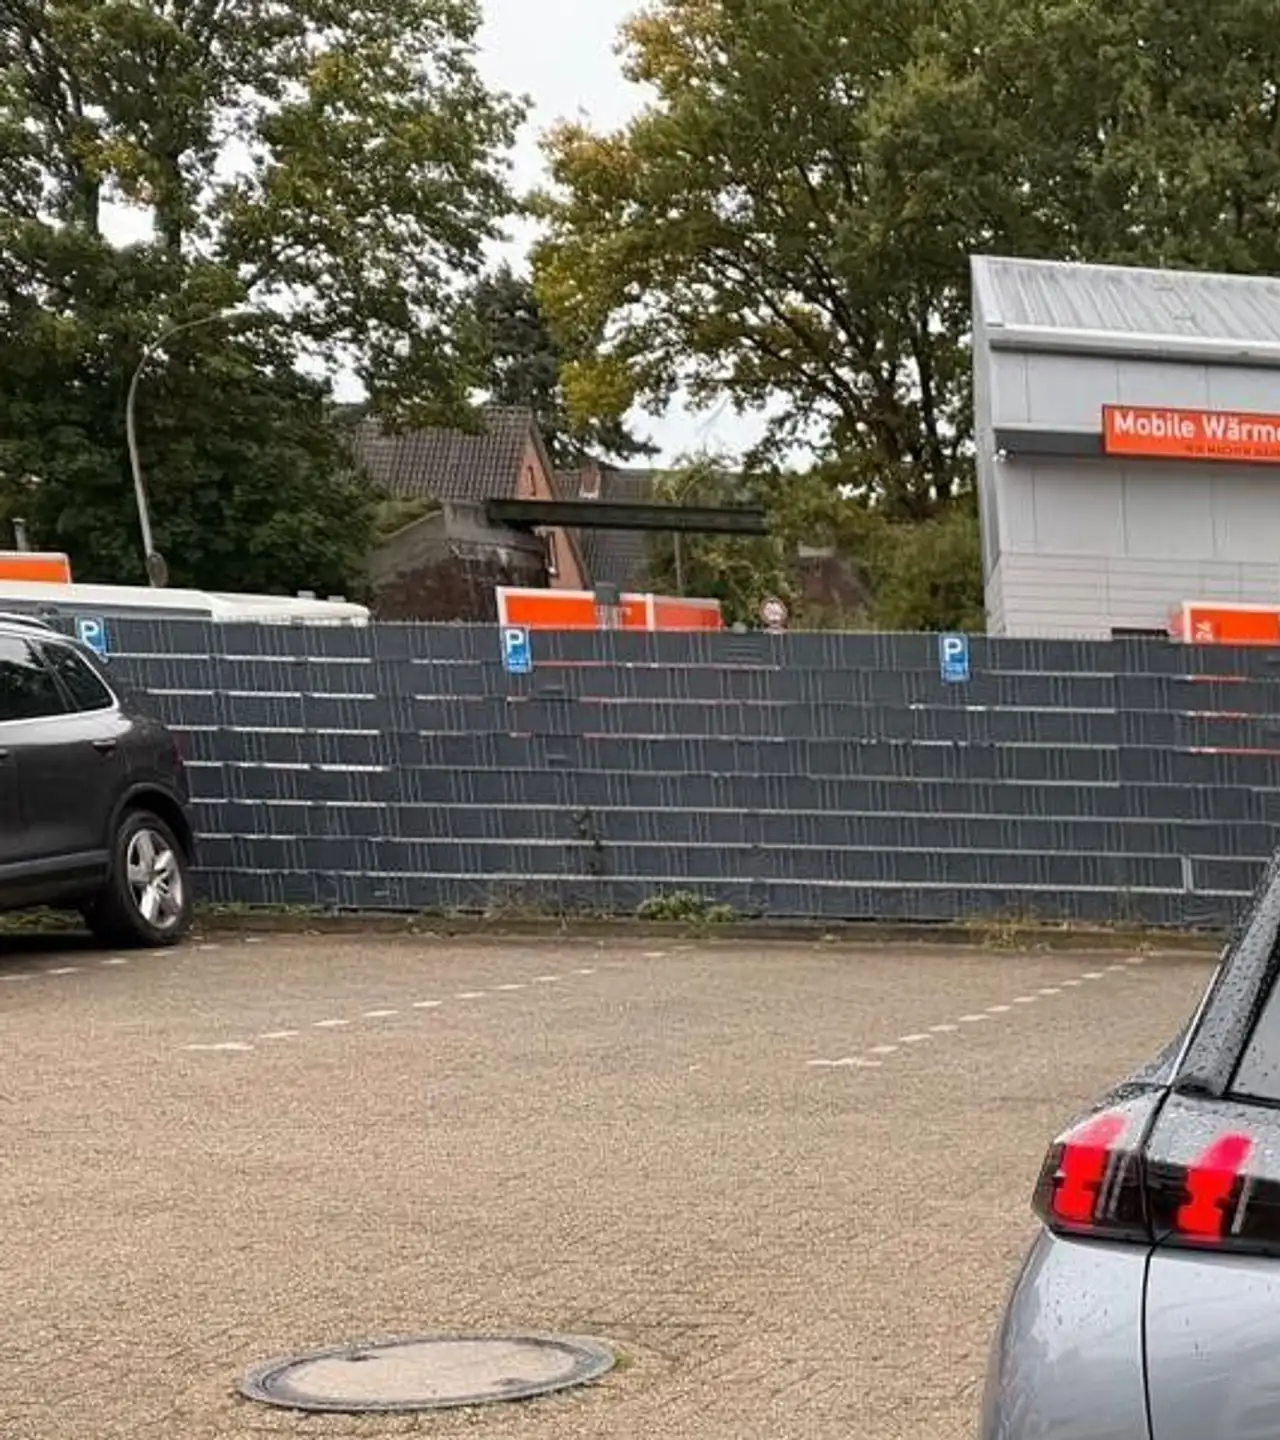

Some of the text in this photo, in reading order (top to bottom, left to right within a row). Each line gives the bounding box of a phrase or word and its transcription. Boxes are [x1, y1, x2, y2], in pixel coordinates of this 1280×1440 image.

[1113, 411, 1196, 438] Mobile
[505, 629, 524, 653] P
[943, 638, 962, 661] P
